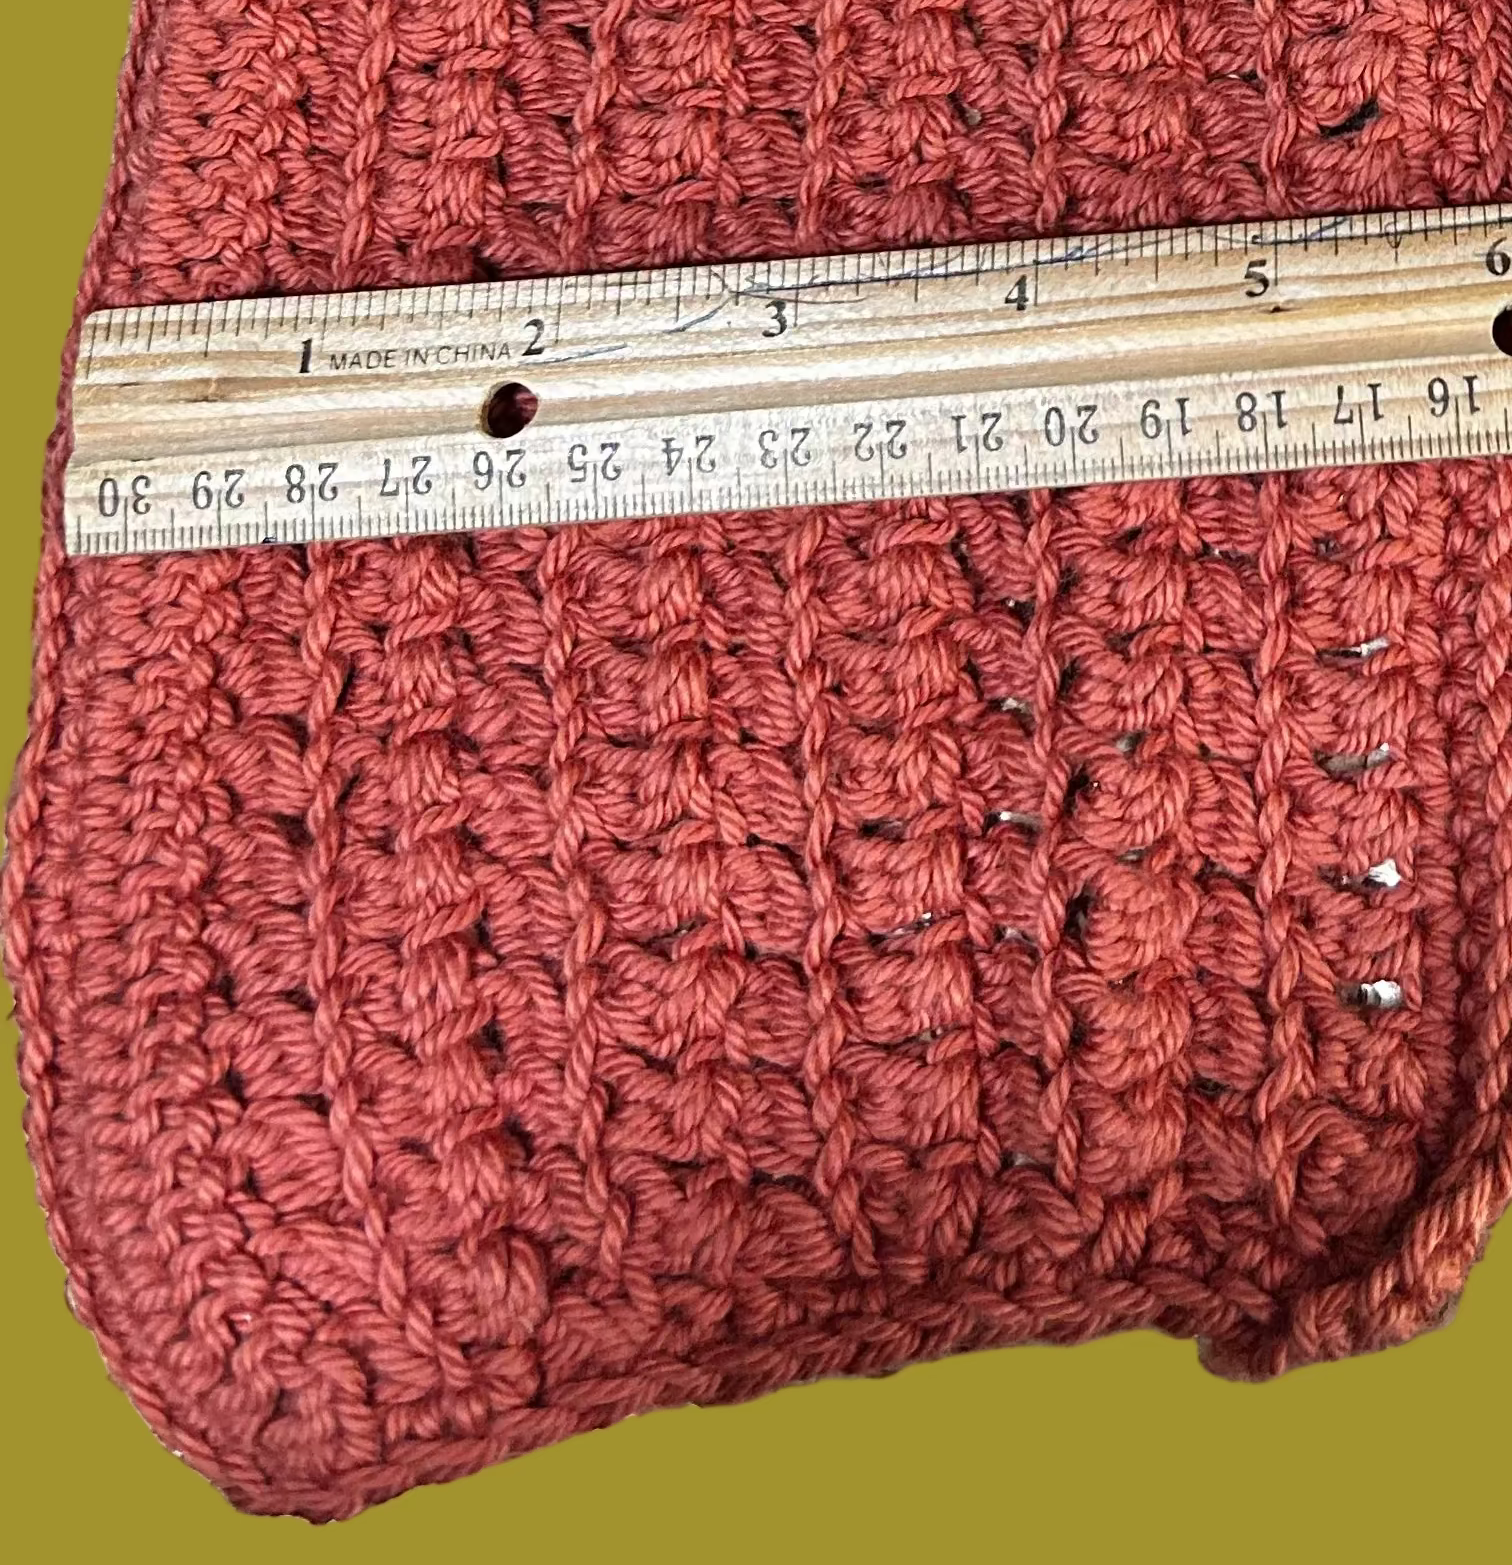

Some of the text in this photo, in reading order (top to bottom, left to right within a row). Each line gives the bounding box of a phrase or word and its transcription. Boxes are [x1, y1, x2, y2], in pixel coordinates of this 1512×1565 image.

[299, 338, 313, 374] 1
[521, 318, 546, 357] 2
[762, 299, 788, 337] 3
[1004, 274, 1030, 311] 4
[1244, 259, 1270, 297] 5
[1485, 236, 1511, 276] 6
[330, 342, 511, 370] MADE IN CHINA
[1235, 390, 1288, 433] 18
[1333, 382, 1384, 425] 17
[1427, 374, 1480, 418] 16
[951, 412, 1004, 454] 21
[1044, 404, 1099, 447] 20
[1140, 397, 1192, 440] 19
[567, 441, 622, 483] 25
[661, 435, 717, 476] 24
[758, 427, 812, 470] 23
[853, 419, 908, 462] 22
[192, 468, 246, 510] 29
[285, 462, 339, 504] 28
[380, 455, 433, 497] 27
[472, 448, 527, 491] 26
[99, 474, 152, 518] 30
